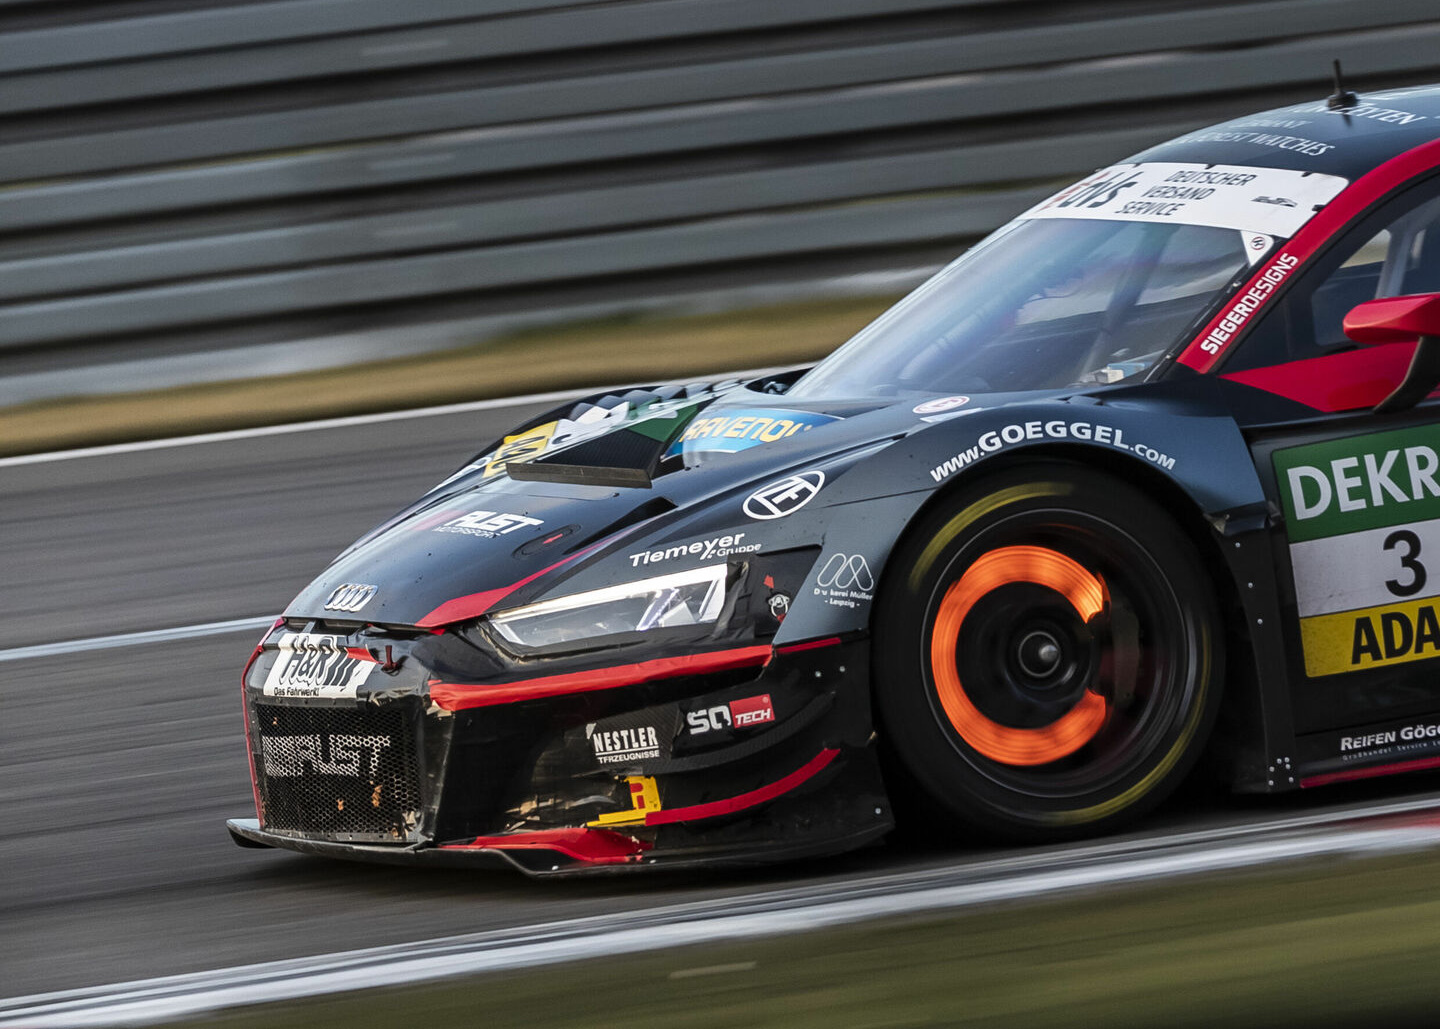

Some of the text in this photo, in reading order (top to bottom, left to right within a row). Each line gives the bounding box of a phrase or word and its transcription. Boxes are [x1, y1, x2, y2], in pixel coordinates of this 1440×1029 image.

[1248, 133, 1336, 156] WATCHES
[1164, 170, 1257, 186] DEUTSCHER
[1140, 185, 1216, 200] VERSAND
[1115, 201, 1186, 216] SERVICE
[1200, 253, 1299, 355] SIEGERDESIGNS
[629, 533, 745, 567] Tiemeyer
[1383, 530, 1428, 597] 3
[273, 687, 286, 696] Das
[735, 709, 771, 725] TECH
[593, 727, 659, 752] NESTLER
[1340, 731, 1396, 751] REIFEN
